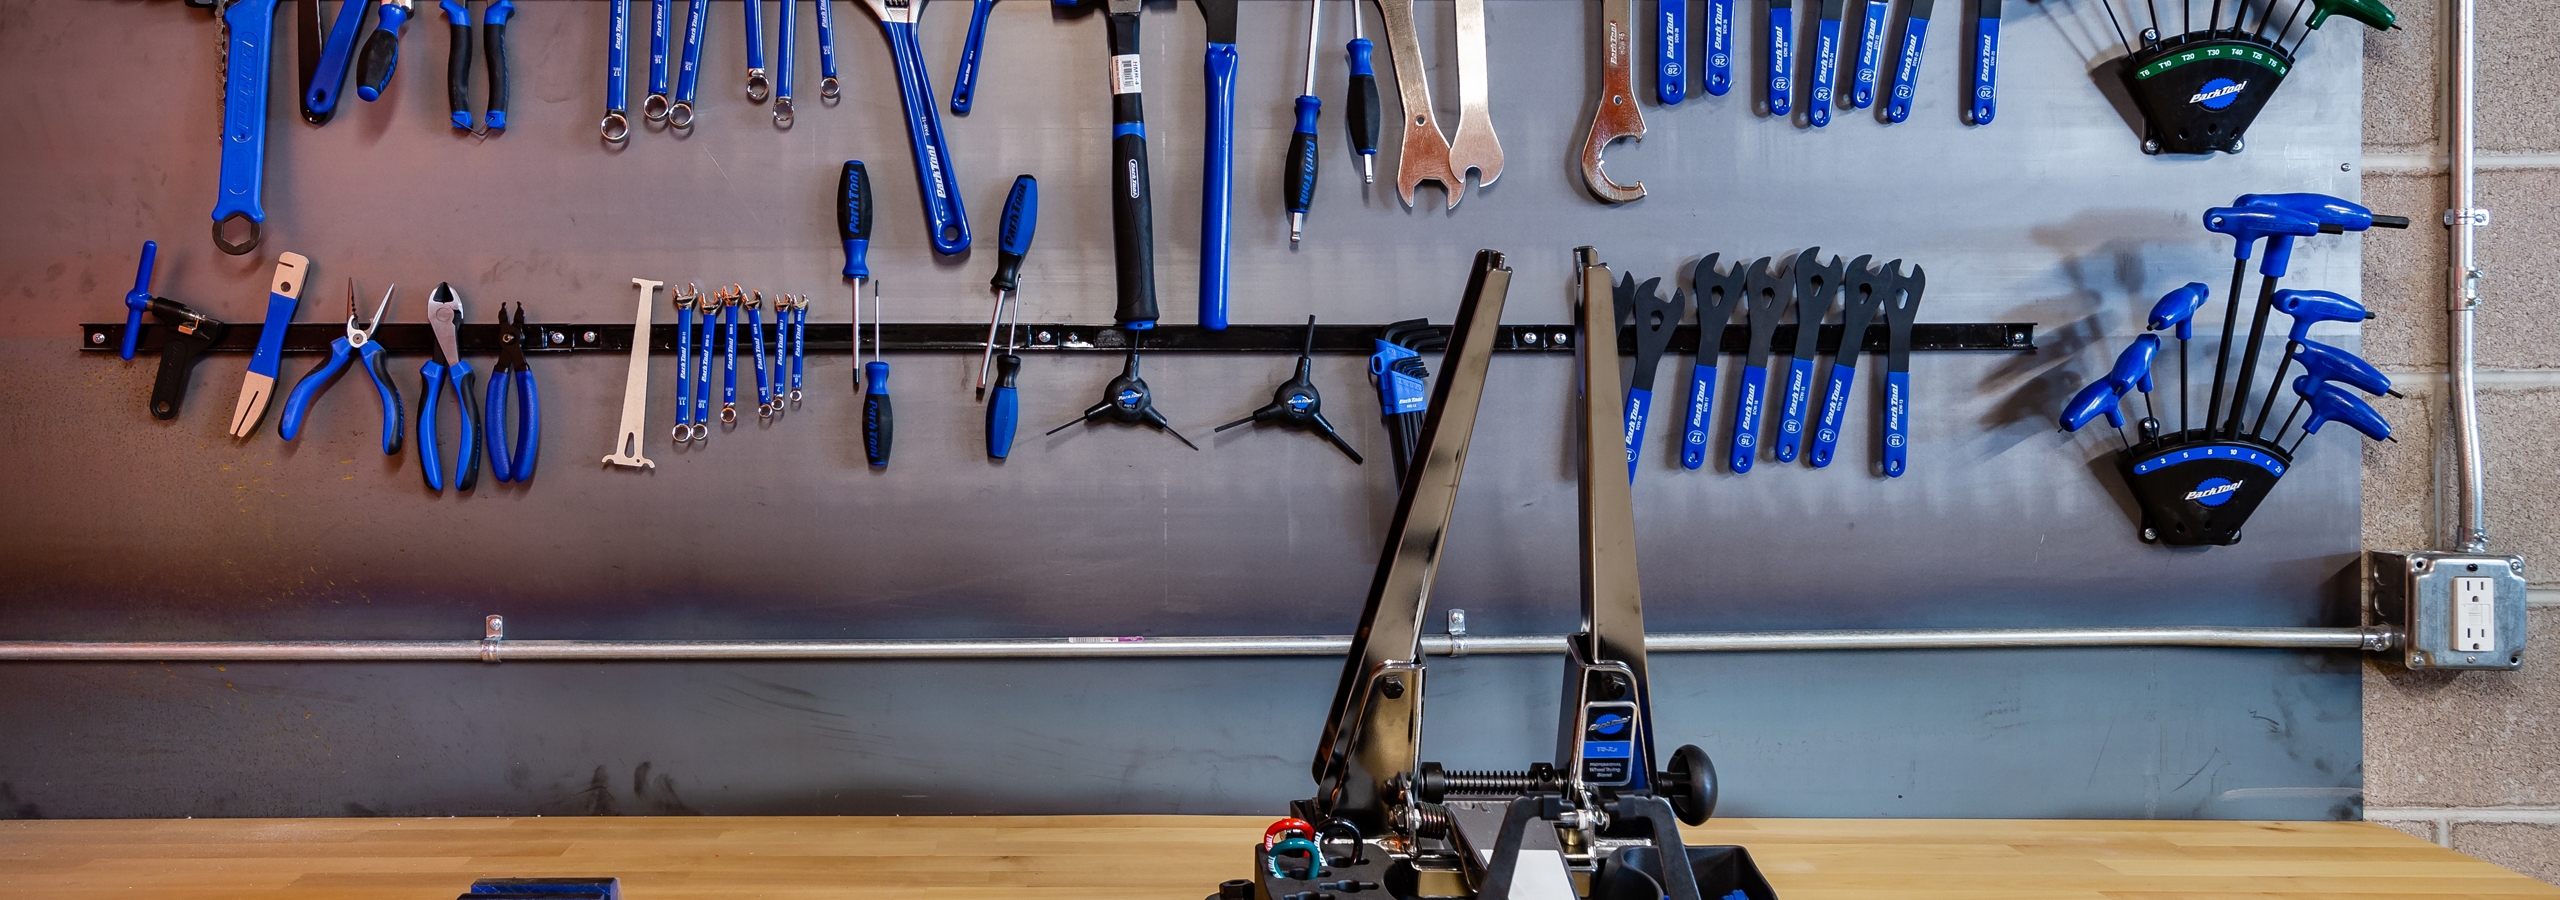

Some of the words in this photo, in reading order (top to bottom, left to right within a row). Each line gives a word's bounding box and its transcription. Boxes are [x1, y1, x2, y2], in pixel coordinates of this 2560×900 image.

[2181, 53, 2195, 62] T20
[2252, 52, 2263, 60] T25
[2158, 60, 2172, 69] T10
[2268, 58, 2277, 67] T15
